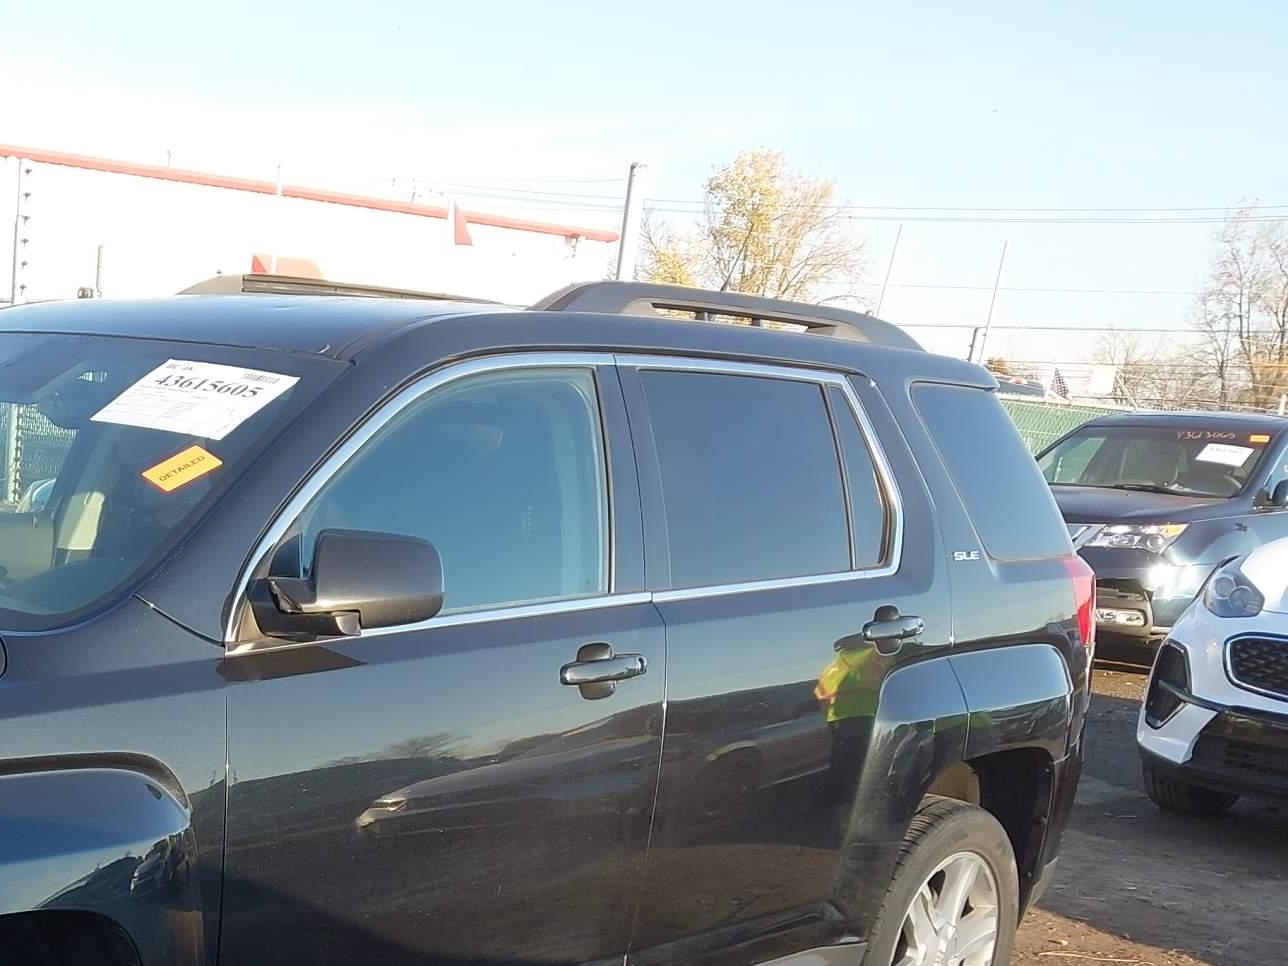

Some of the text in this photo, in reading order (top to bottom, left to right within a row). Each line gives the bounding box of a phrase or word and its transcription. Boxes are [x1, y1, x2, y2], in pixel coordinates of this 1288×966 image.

[155, 374, 265, 398] 43615605
[158, 455, 206, 482] DETAILED
[953, 550, 981, 561] SLE
